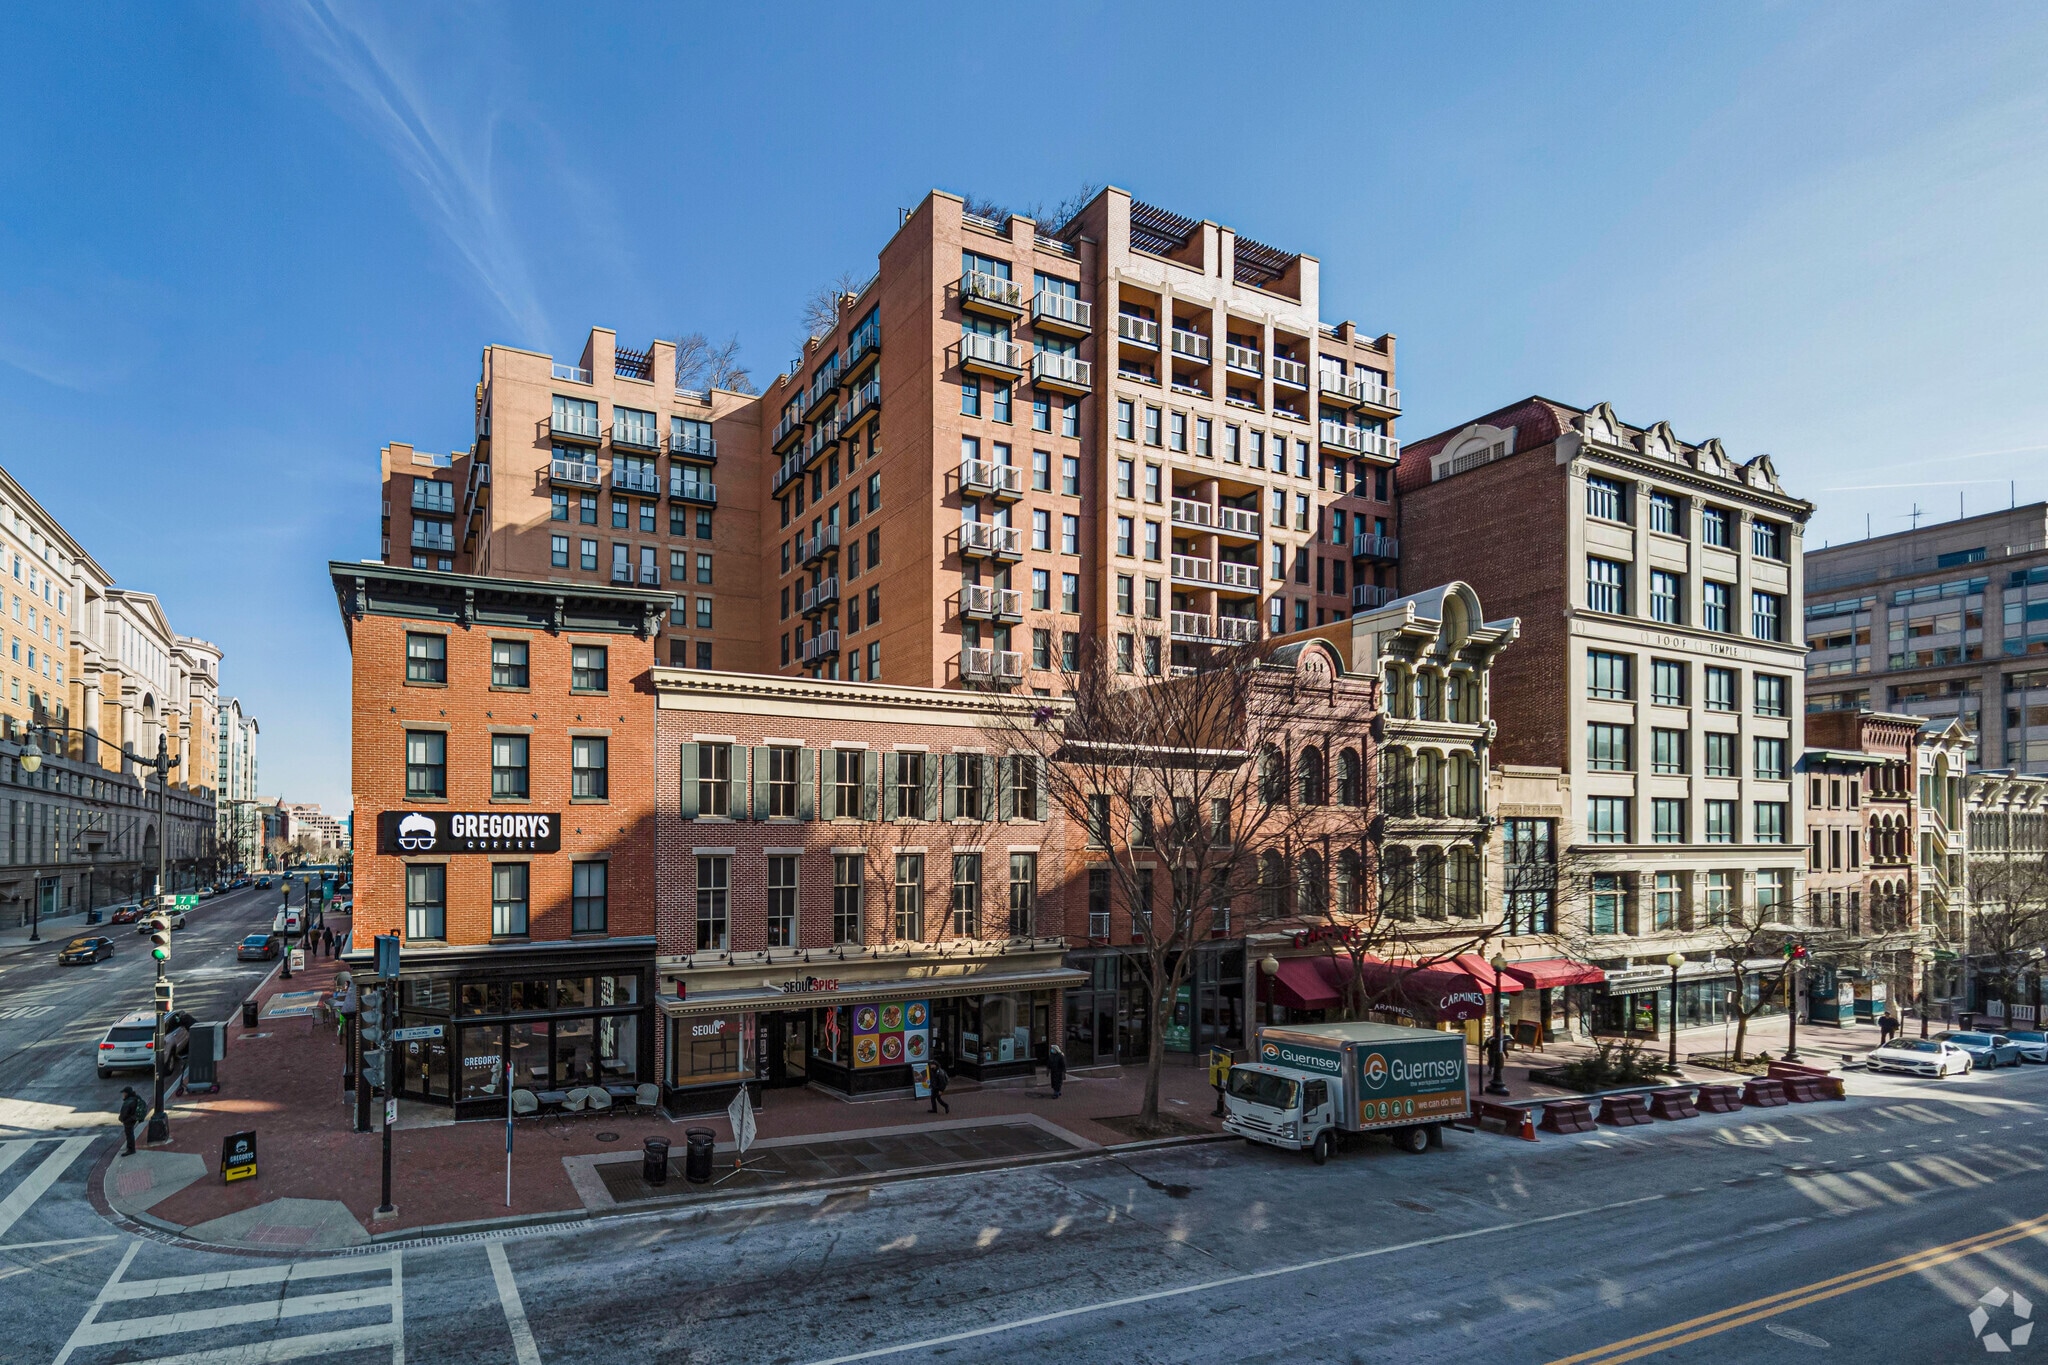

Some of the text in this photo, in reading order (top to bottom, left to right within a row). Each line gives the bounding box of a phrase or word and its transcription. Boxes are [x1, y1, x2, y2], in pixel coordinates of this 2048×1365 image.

[1710, 643, 1738, 657] TEMPLE
[452, 814, 550, 838] GREGORYS
[467, 841, 535, 849] COFFEE
[180, 896, 187, 904] 7
[464, 1055, 501, 1067] GREGORYS
[1281, 1049, 1341, 1072] Guernsey
[1391, 1059, 1462, 1082] Guernsey
[1418, 1096, 1462, 1109] we can do that
